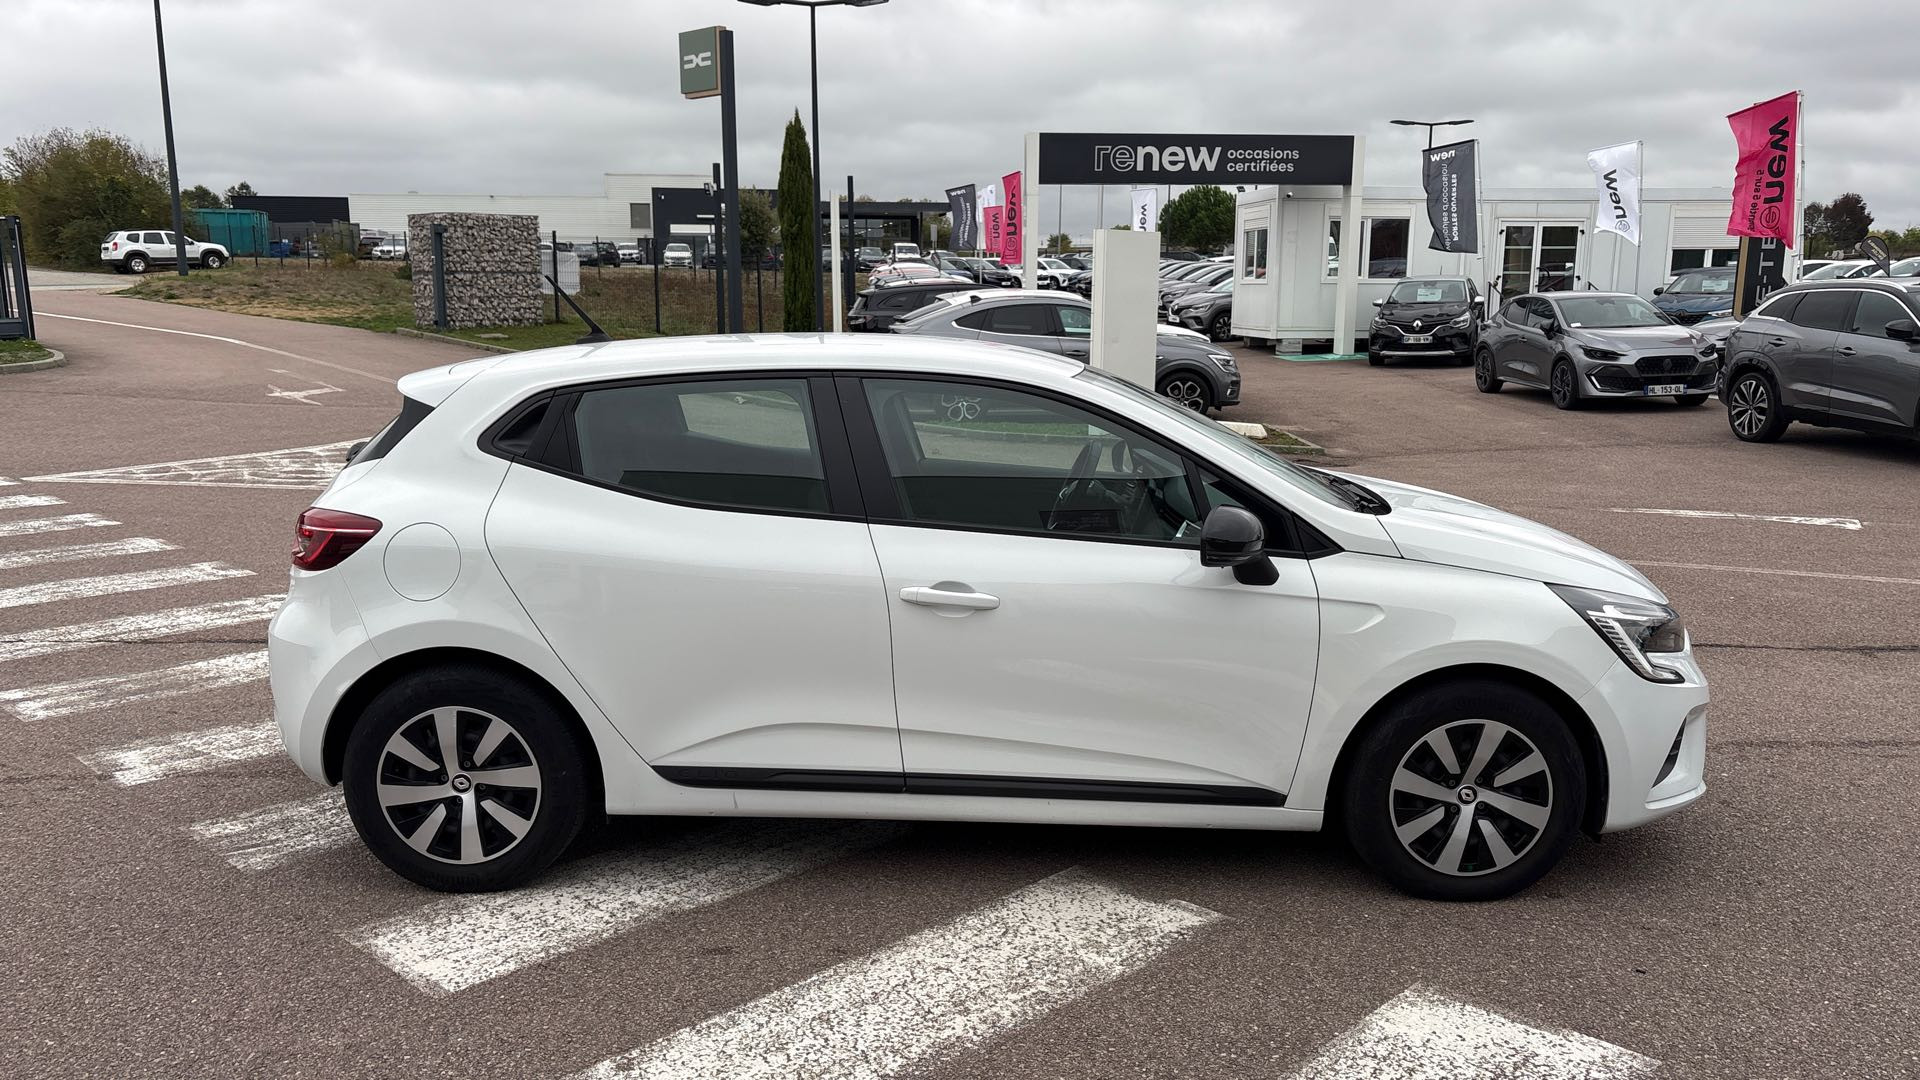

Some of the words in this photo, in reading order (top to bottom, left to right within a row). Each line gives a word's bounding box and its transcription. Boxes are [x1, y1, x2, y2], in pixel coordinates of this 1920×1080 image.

[1094, 145, 1222, 172] renew
[1227, 147, 1300, 160] occasions
[1226, 159, 1294, 172] certifiées
